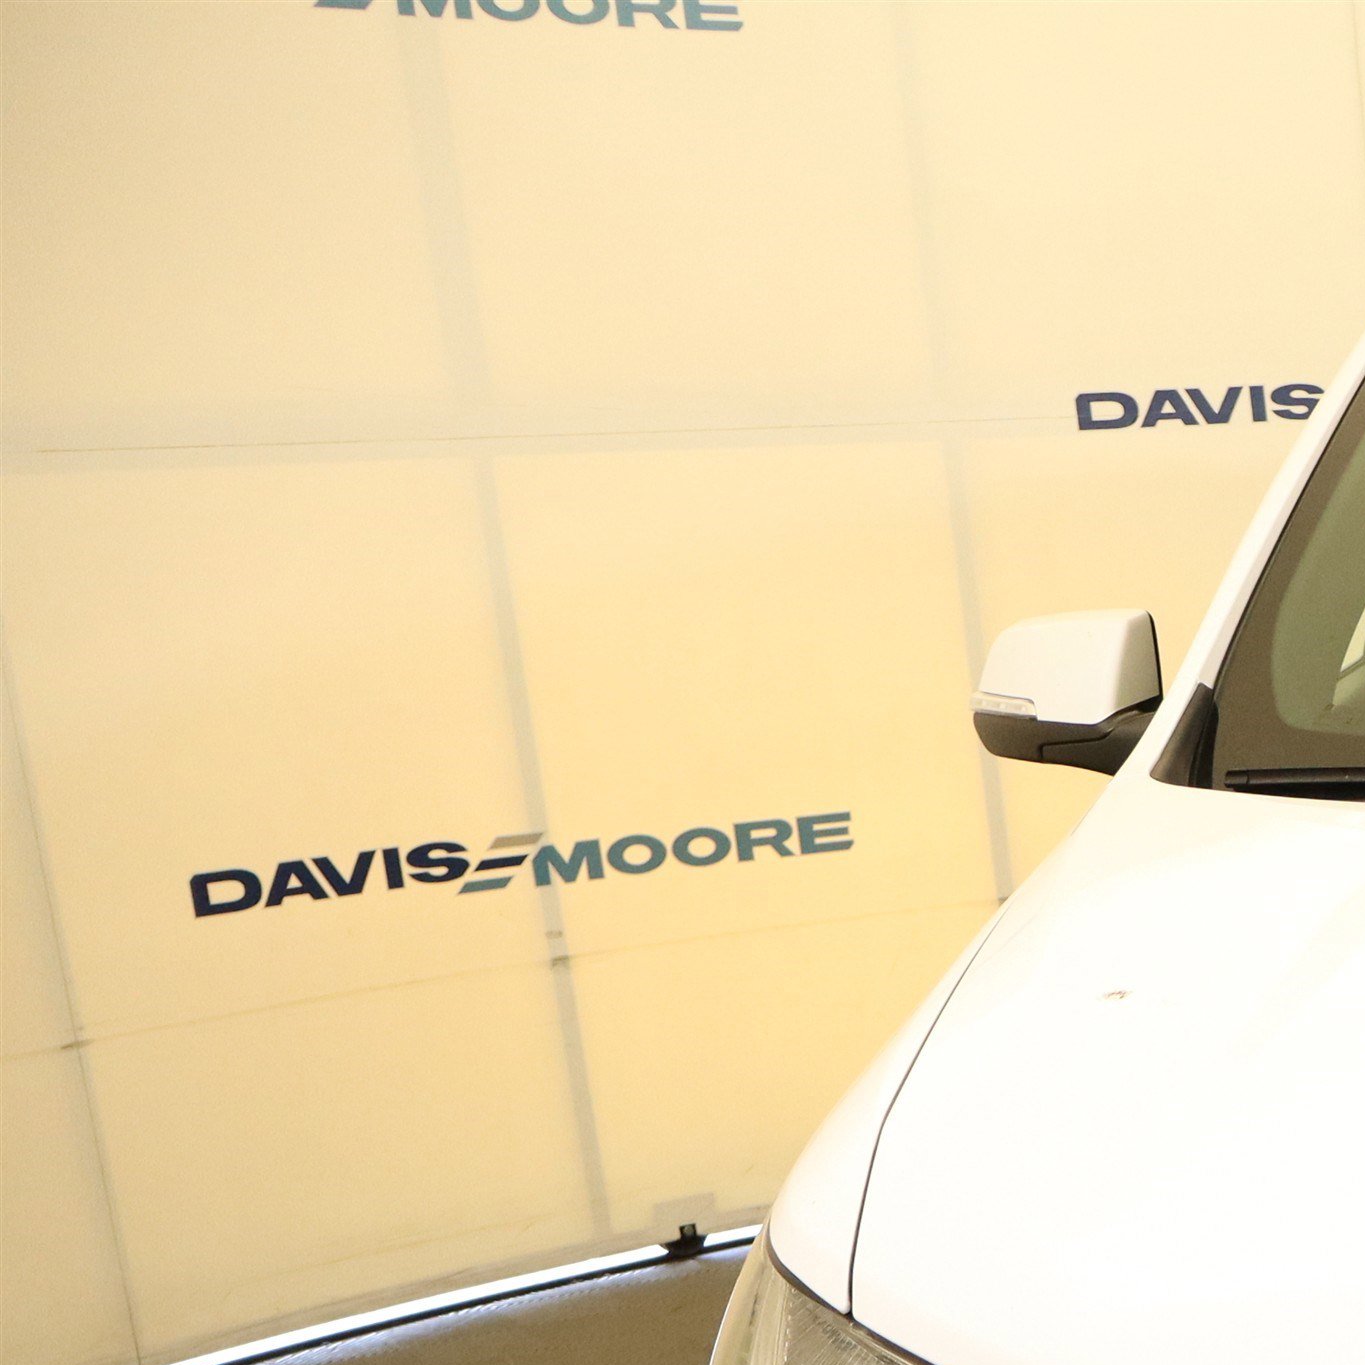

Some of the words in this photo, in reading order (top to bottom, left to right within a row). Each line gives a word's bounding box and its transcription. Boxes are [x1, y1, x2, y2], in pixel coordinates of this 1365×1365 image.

[1075, 383, 1325, 430] DAVIS
[189, 841, 471, 918] DAVIS
[532, 811, 855, 886] MOORE
